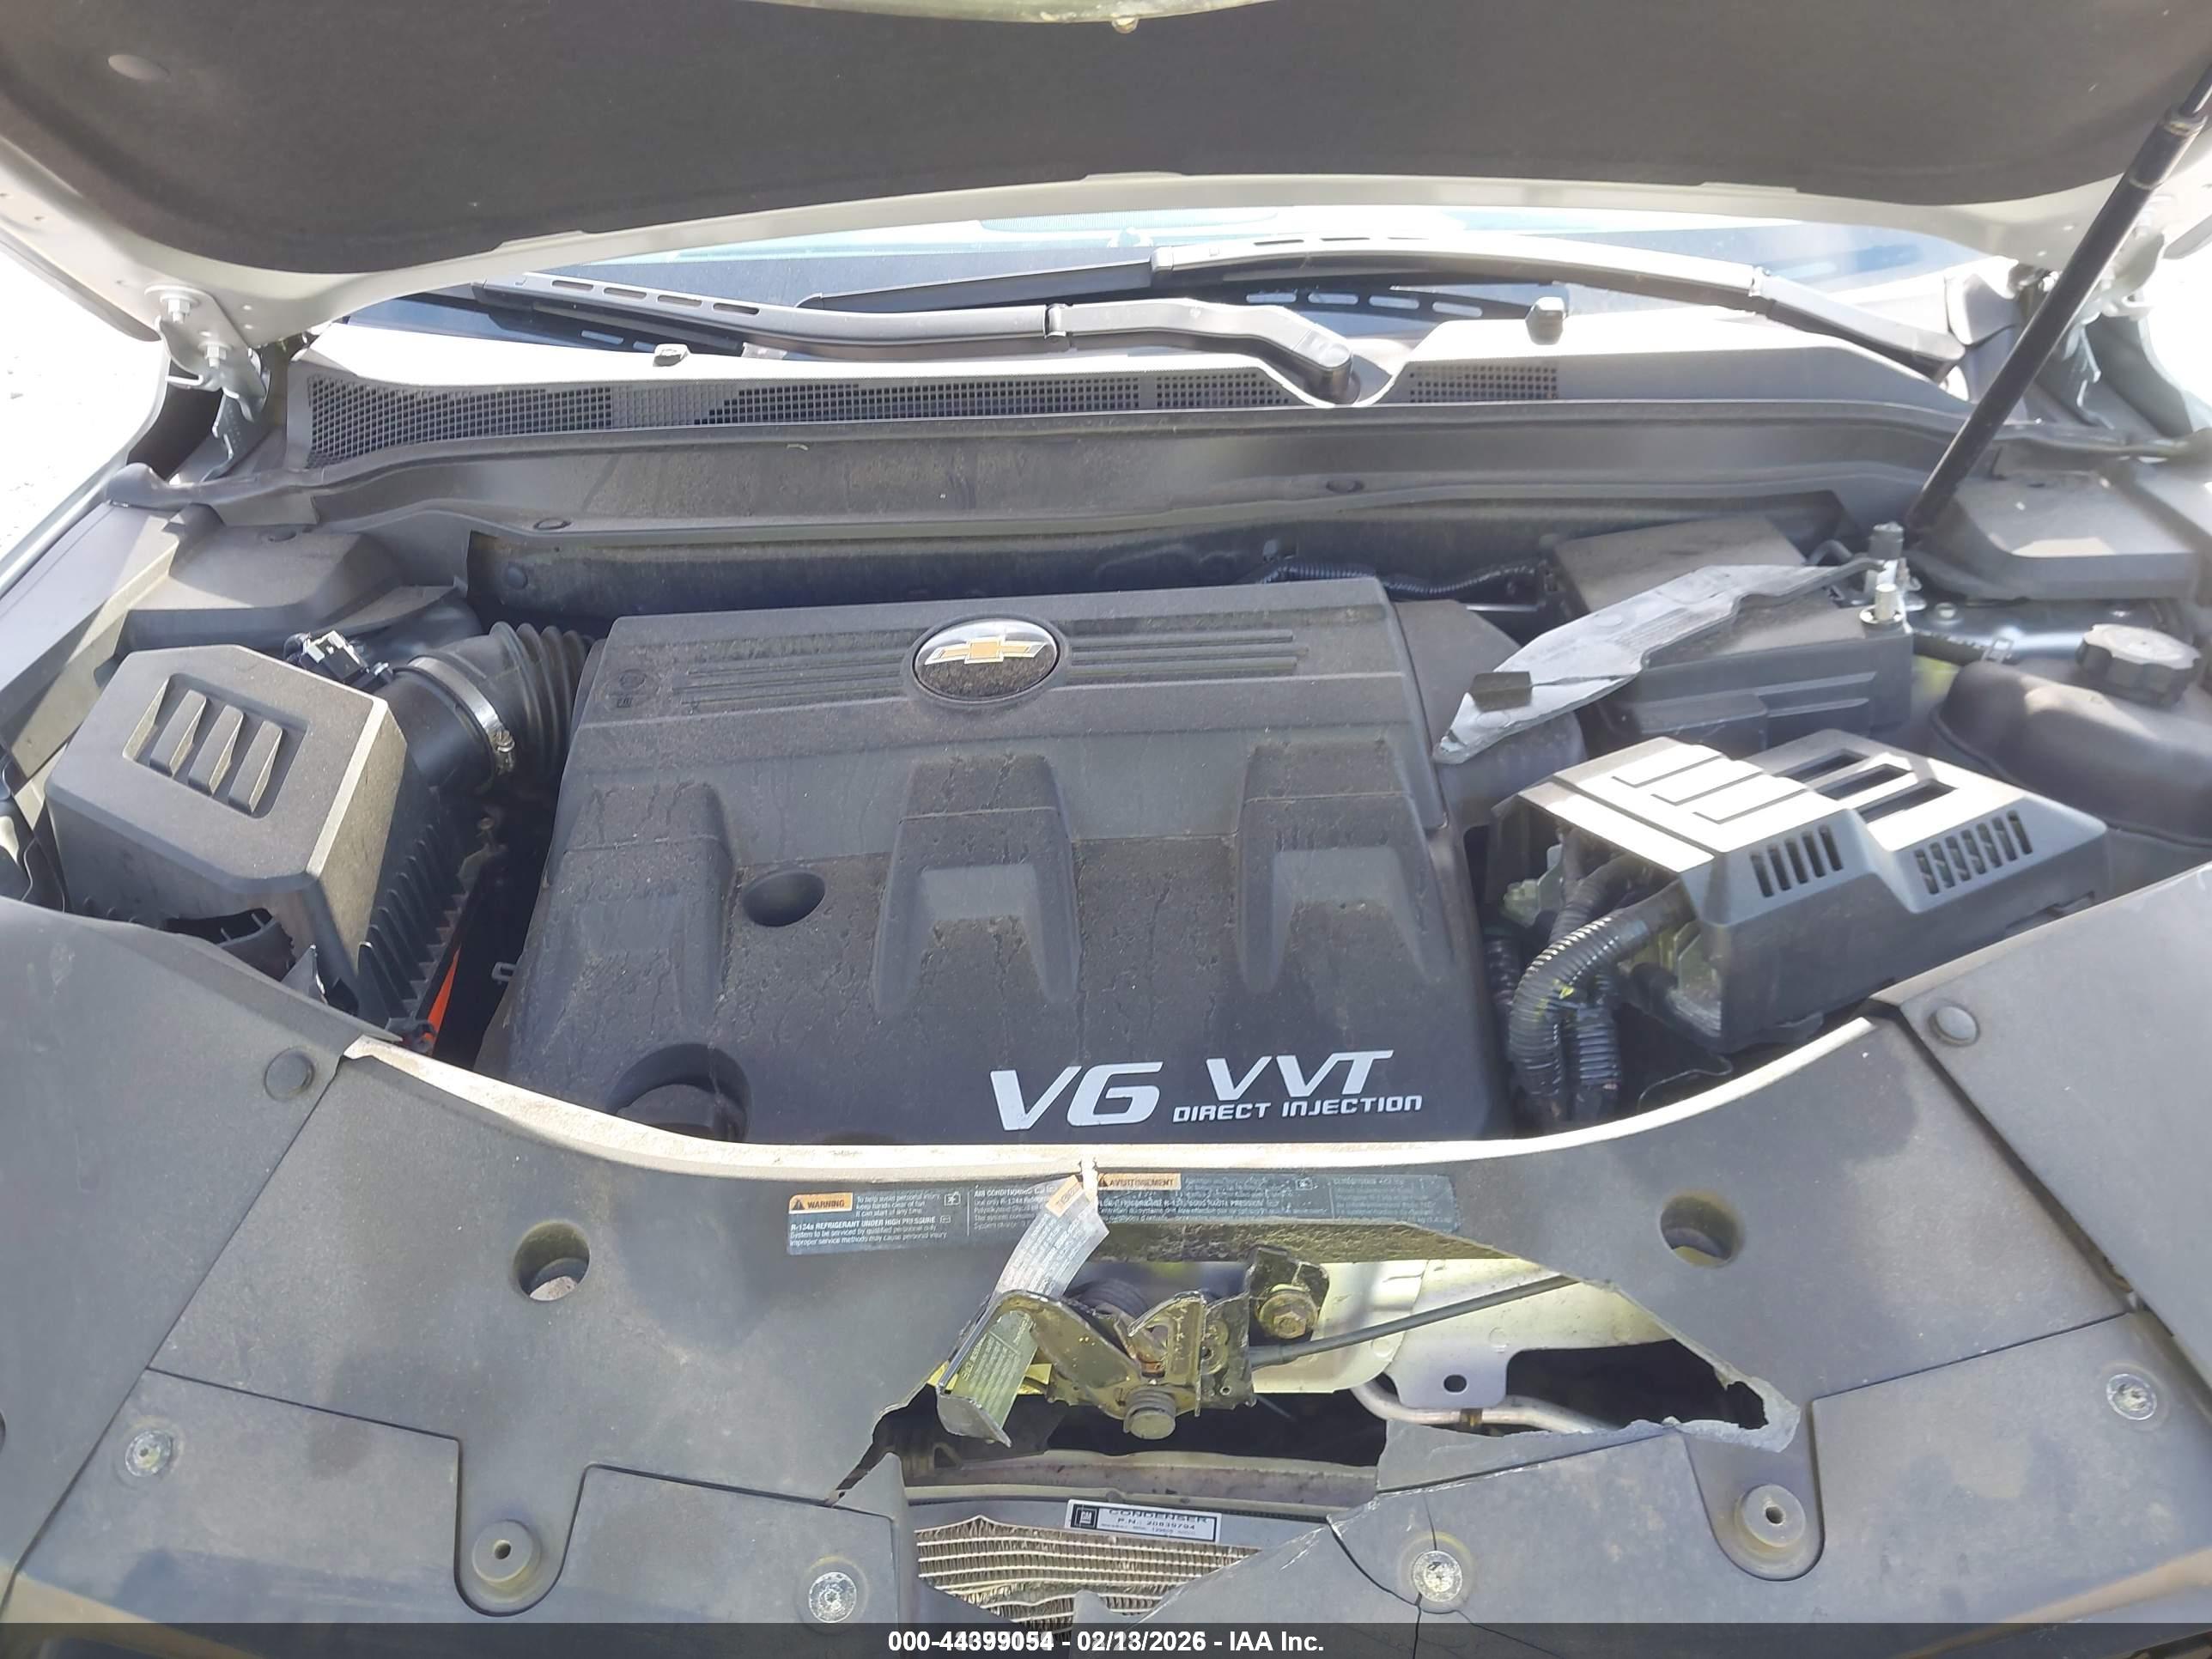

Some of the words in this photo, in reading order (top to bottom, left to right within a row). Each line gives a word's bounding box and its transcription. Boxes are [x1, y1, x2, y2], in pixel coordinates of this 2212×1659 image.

[1206, 1049, 1394, 1102] VVT
[990, 1061, 1163, 1131] V6
[1172, 1103, 1271, 1123] DIRECT
[1282, 1095, 1422, 1118] INJECTION
[807, 1200, 844, 1208] WARNING
[902, 1216, 935, 1224] PRESSURE
[1082, 1511, 1091, 1520] GM
[1109, 1510, 1209, 1523] CONDENSER
